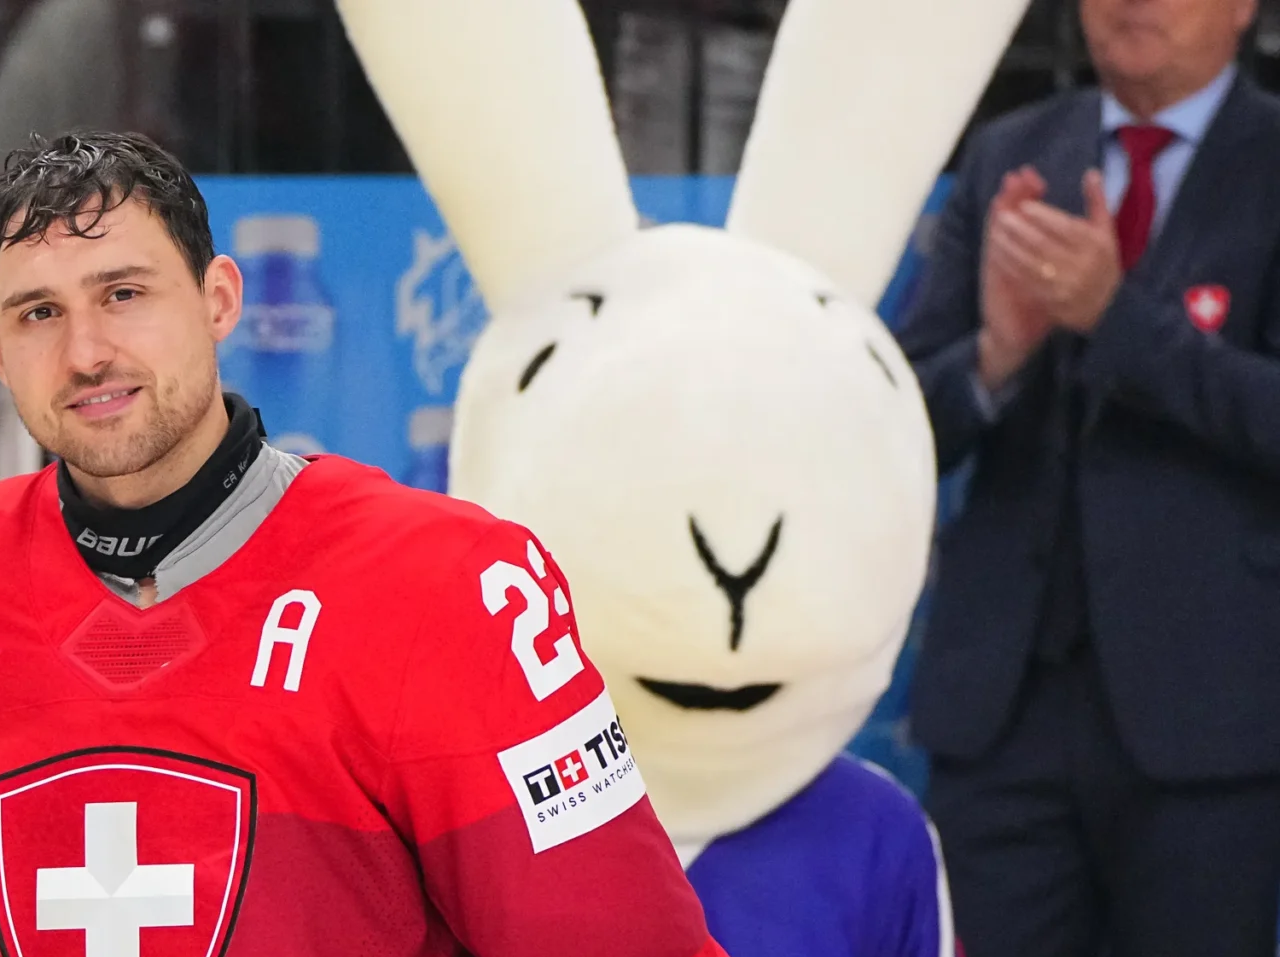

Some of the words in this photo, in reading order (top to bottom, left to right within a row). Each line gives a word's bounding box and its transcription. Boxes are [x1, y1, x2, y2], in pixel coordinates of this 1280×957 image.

[250, 589, 322, 692] A
[584, 714, 628, 769] TIS
[537, 792, 587, 823] SWISS
